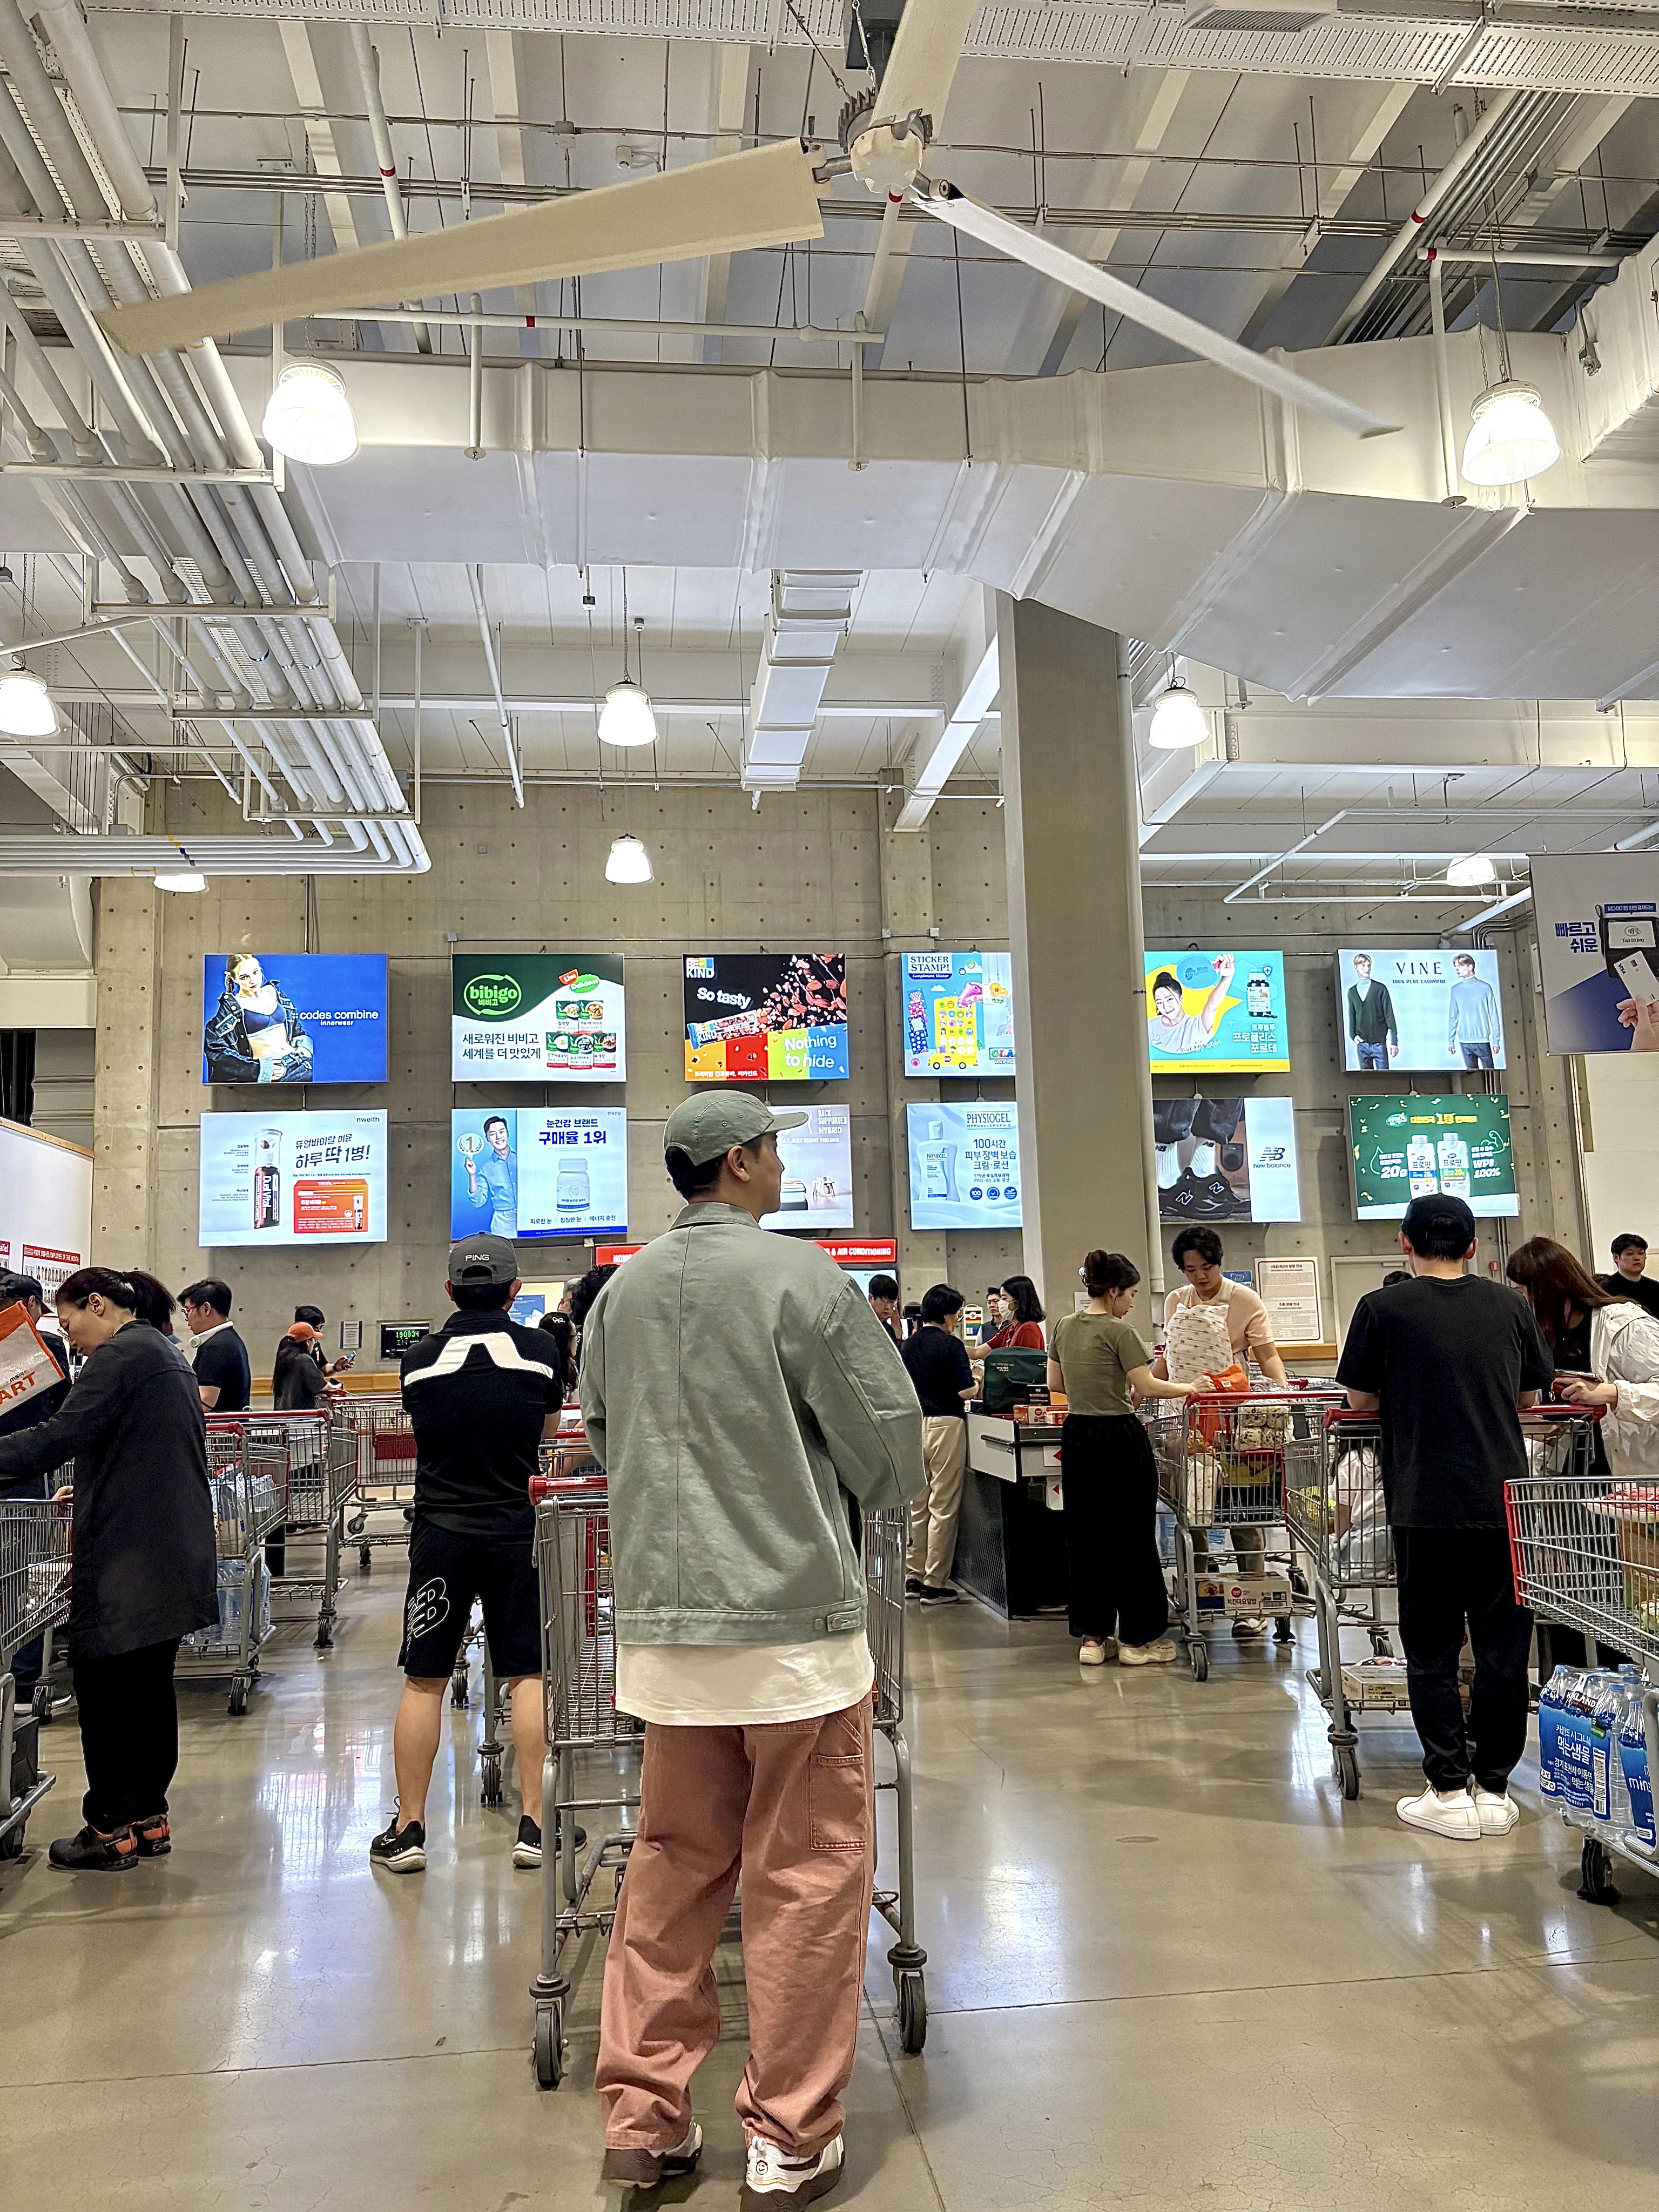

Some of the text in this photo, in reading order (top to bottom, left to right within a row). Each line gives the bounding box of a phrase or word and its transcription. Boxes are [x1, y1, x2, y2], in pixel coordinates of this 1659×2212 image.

[1555, 922, 1596, 937] 빠르고
[1570, 938, 1597, 953] 쉬운
[686, 968, 714, 978] KIND
[911, 963, 949, 972] STAMP!
[1395, 962, 1442, 975] VINE
[470, 985, 517, 1003] bibigo
[697, 987, 751, 1010] So tasty
[300, 1009, 379, 1020] codes combine
[463, 1033, 539, 1044] 새로워진 비비고
[785, 1035, 837, 1051] Nothing
[1251, 1043, 1277, 1053] 포르테
[462, 1048, 495, 1060] 세계를
[497, 1048, 507, 1059] 더
[510, 1048, 540, 1059] 맛있게
[785, 1054, 835, 1069] to hide
[547, 1118, 598, 1128] 눈건강 브랜드
[818, 1116, 847, 1125] SUPPORTER
[967, 1113, 1011, 1123] PHYSIOGEL
[539, 1131, 606, 1145] 구매율 1위
[974, 1138, 1006, 1149] 100시간
[295, 1145, 370, 1168] 하루 딱 1병!
[1473, 1158, 1494, 1168] WPI
[1380, 1165, 1408, 1178] 20g
[1474, 1167, 1501, 1178] 100%
[848, 1247, 891, 1256] CONDITIONING
[1566, 1692, 1596, 1707] KKLAND
